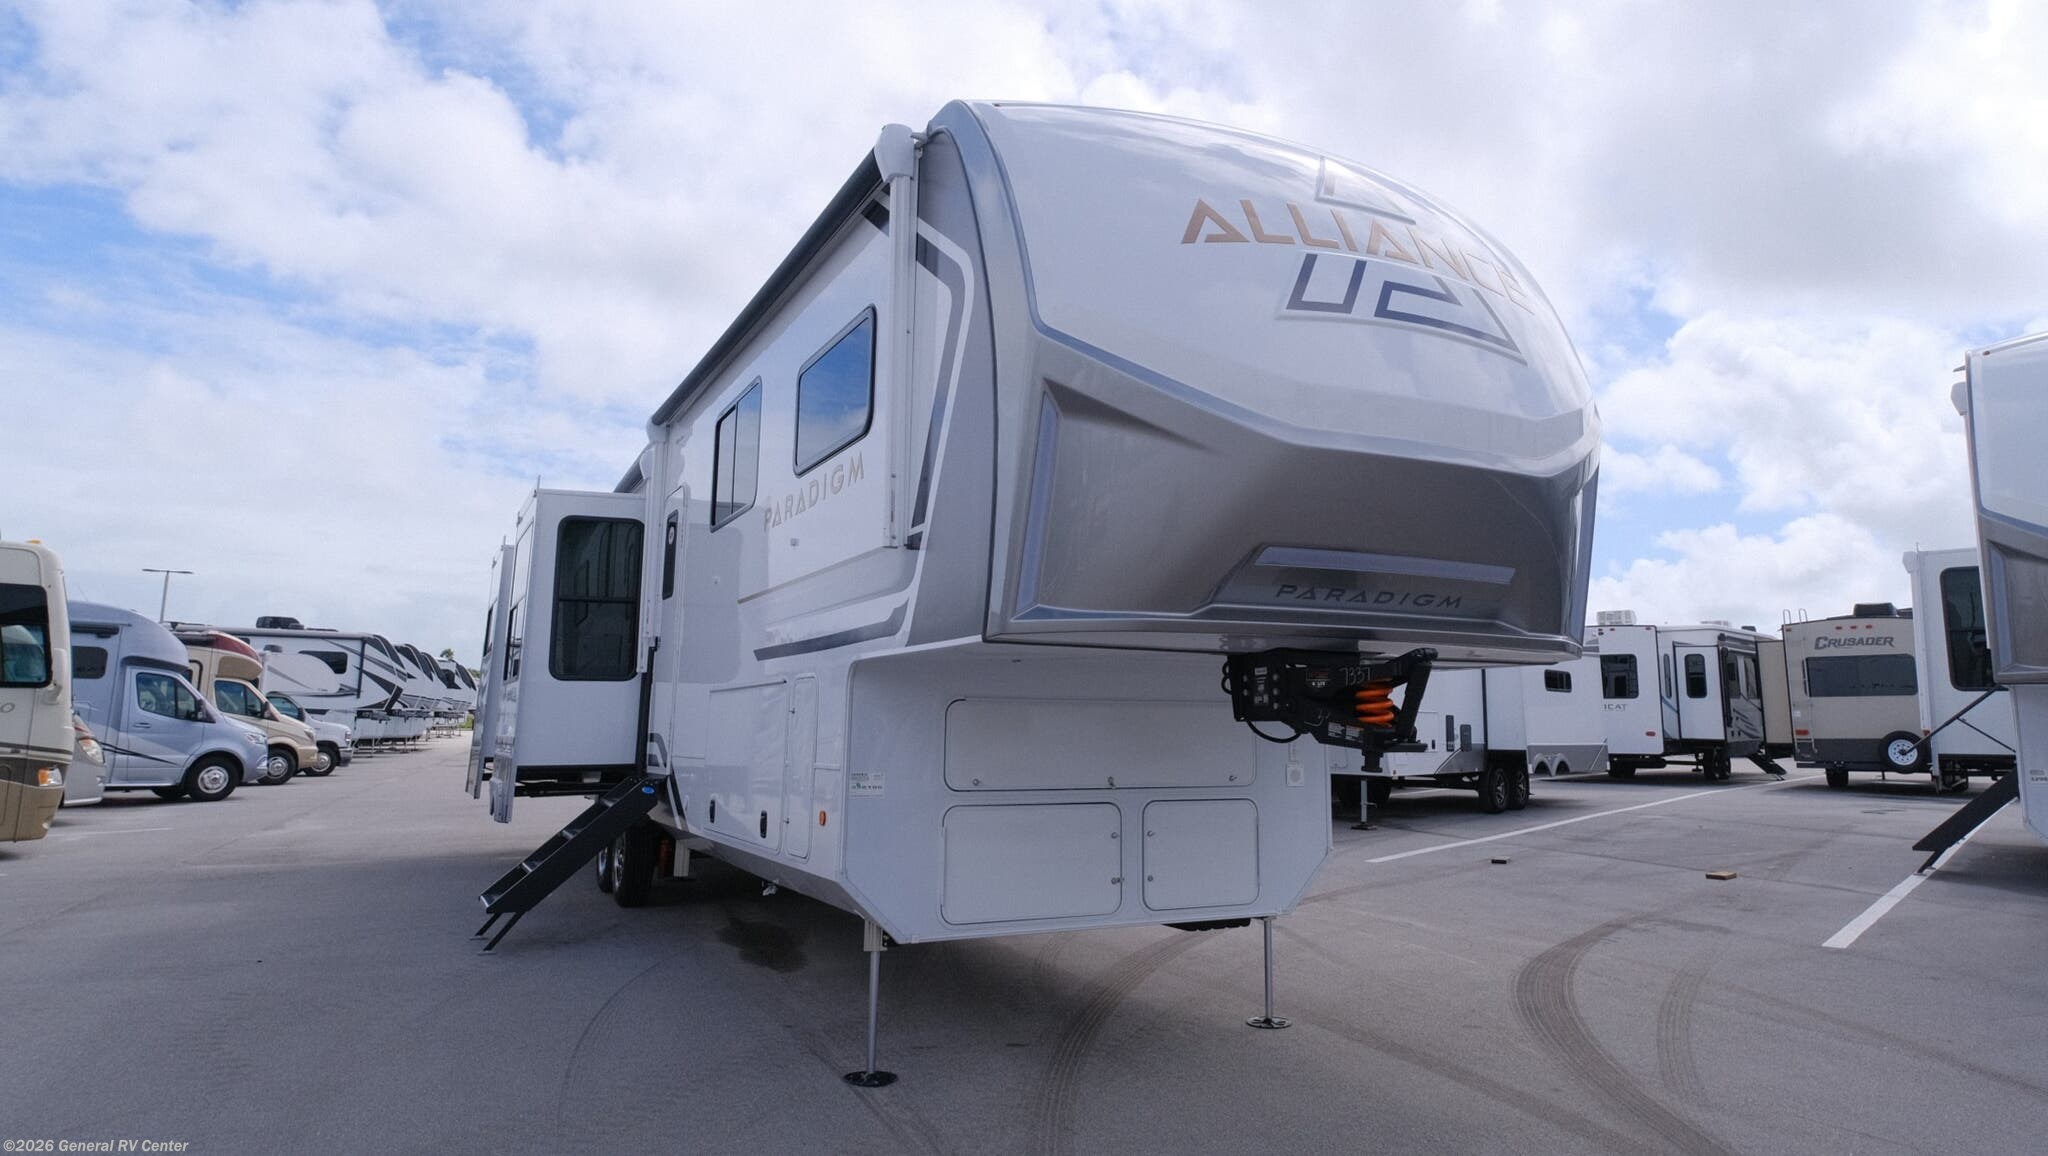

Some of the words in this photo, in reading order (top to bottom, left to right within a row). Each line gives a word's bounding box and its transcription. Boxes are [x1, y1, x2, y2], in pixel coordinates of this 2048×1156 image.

[1180, 197, 1535, 315] ALLIANCE
[763, 451, 865, 533] PARADIGM
[1275, 584, 1464, 609] PARADIGM
